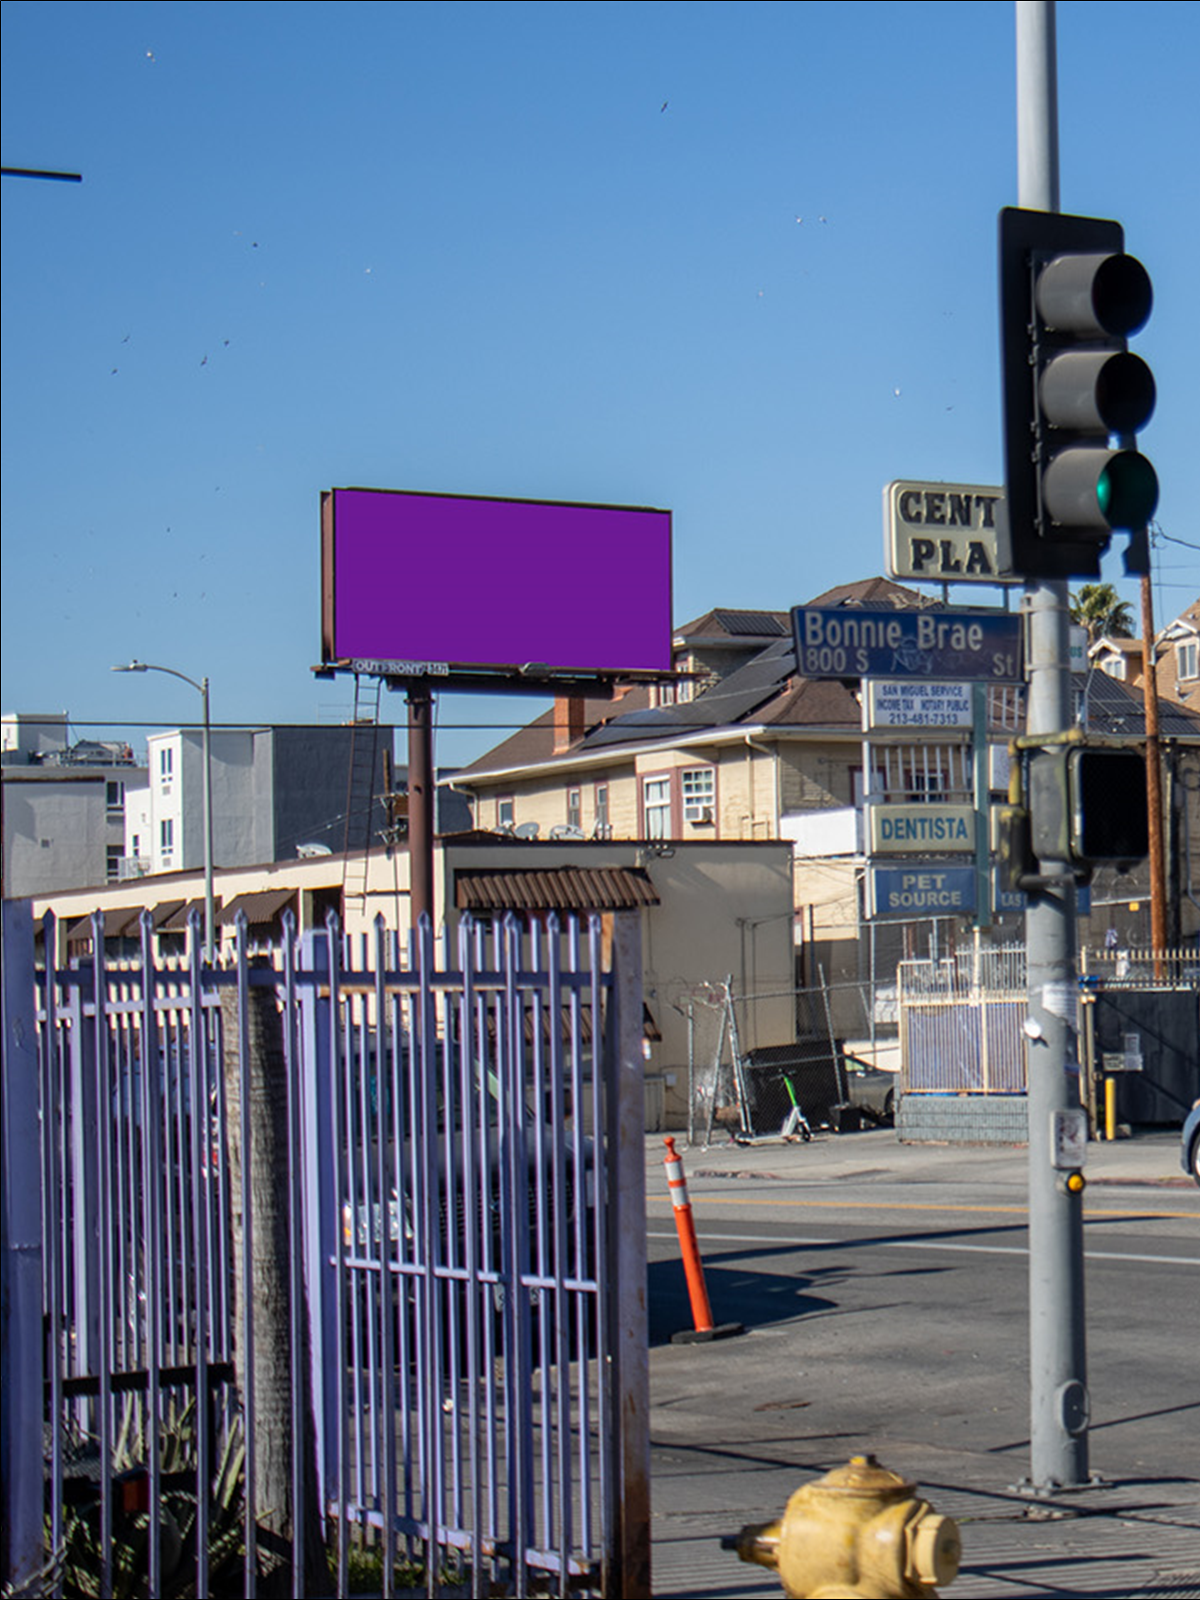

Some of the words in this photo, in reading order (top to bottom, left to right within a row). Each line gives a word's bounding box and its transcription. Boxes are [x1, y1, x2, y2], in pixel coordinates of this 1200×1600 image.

[900, 491, 1001, 528] CENT
[911, 538, 993, 574] PLA
[804, 611, 901, 648] Bonnie
[917, 615, 984, 650] Brae
[806, 648, 847, 672] 800
[855, 651, 870, 673] S
[992, 653, 1014, 677] St
[882, 685, 899, 696] SAN
[900, 686, 929, 697] MIGUEL
[931, 686, 963, 697] SERVICE
[877, 700, 901, 711] INCOME
[902, 700, 914, 711] TAX
[921, 701, 945, 711] NOTARY
[947, 701, 969, 712] PUBLIC
[889, 713, 958, 725] 213-481-7313
[881, 818, 968, 840] DENTISTA
[902, 874, 946, 890] PET
[889, 891, 962, 907] SOURCE
